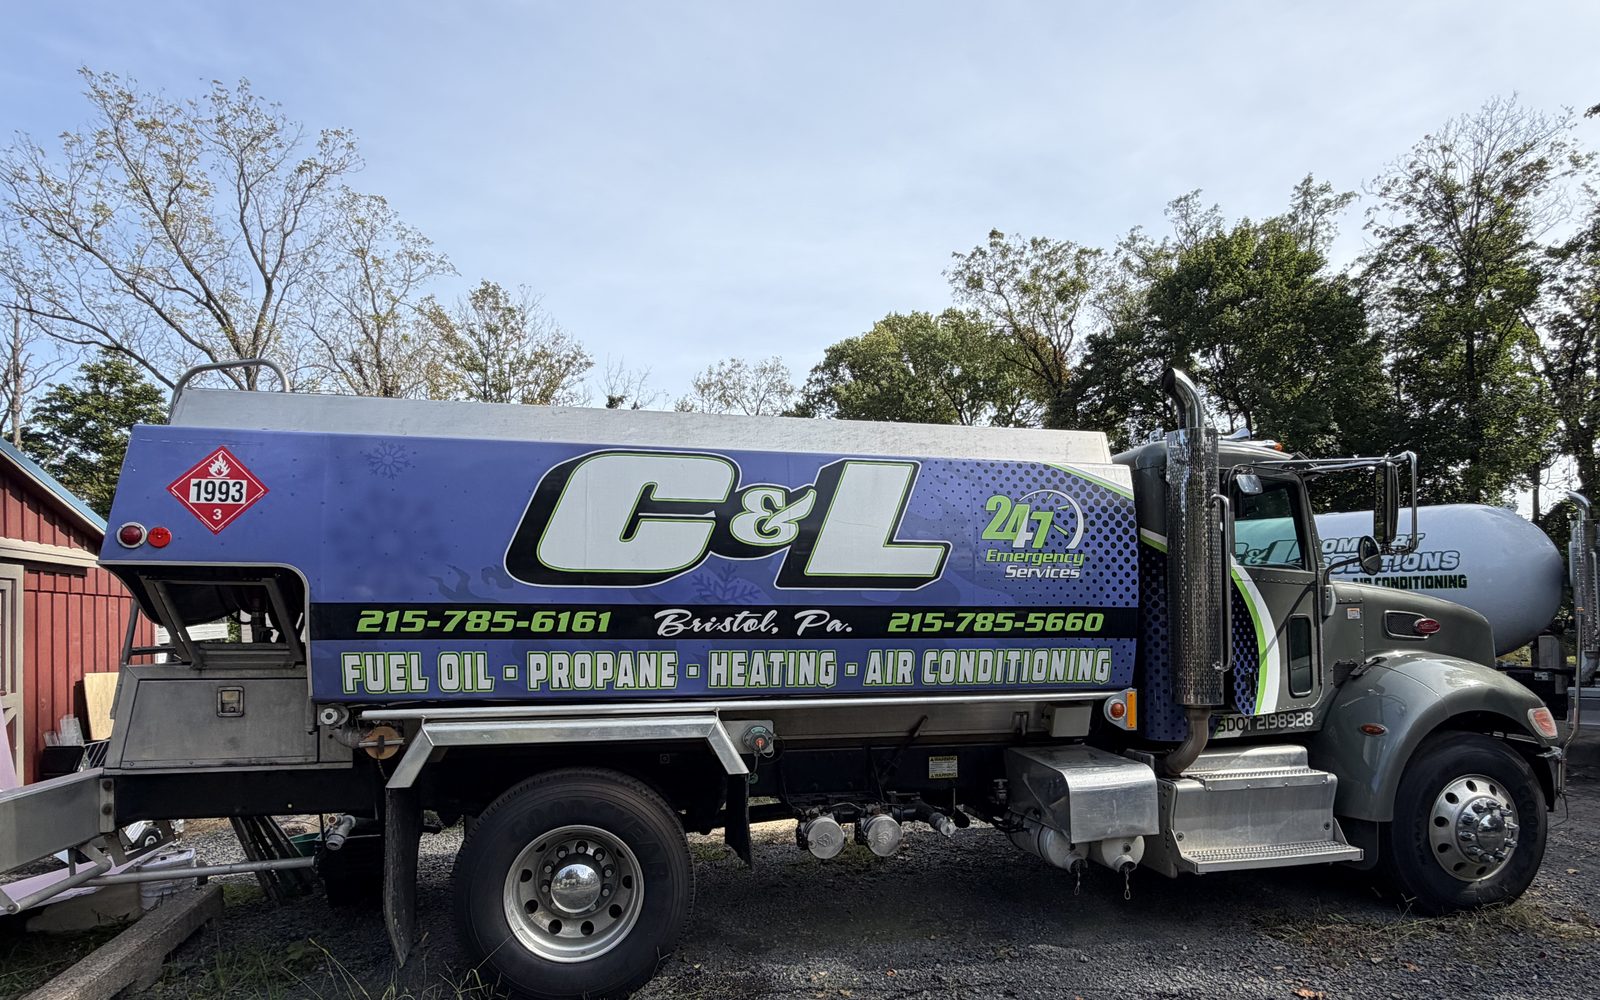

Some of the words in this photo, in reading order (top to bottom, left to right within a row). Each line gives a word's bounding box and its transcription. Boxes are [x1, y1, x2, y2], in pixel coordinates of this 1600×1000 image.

[192, 480, 244, 502] 1993
[212, 508, 222, 520] 3
[505, 450, 951, 589] C&L
[985, 549, 1085, 567] Emergency
[1005, 565, 1080, 579] Services
[356, 610, 611, 632] 215-785-6161
[654, 608, 779, 637] Bristol,
[794, 609, 853, 636] Pa.
[887, 612, 1105, 632] 215-785-5660
[342, 652, 429, 693] FUEL
[438, 652, 495, 692] OIL
[527, 651, 679, 691] PROPANE
[708, 650, 837, 688] HEATING
[863, 649, 916, 686] AIR
[922, 647, 1112, 685] CONDITIONING
[1217, 716, 1251, 732] SDOT
[1256, 711, 1314, 730] 2198928
